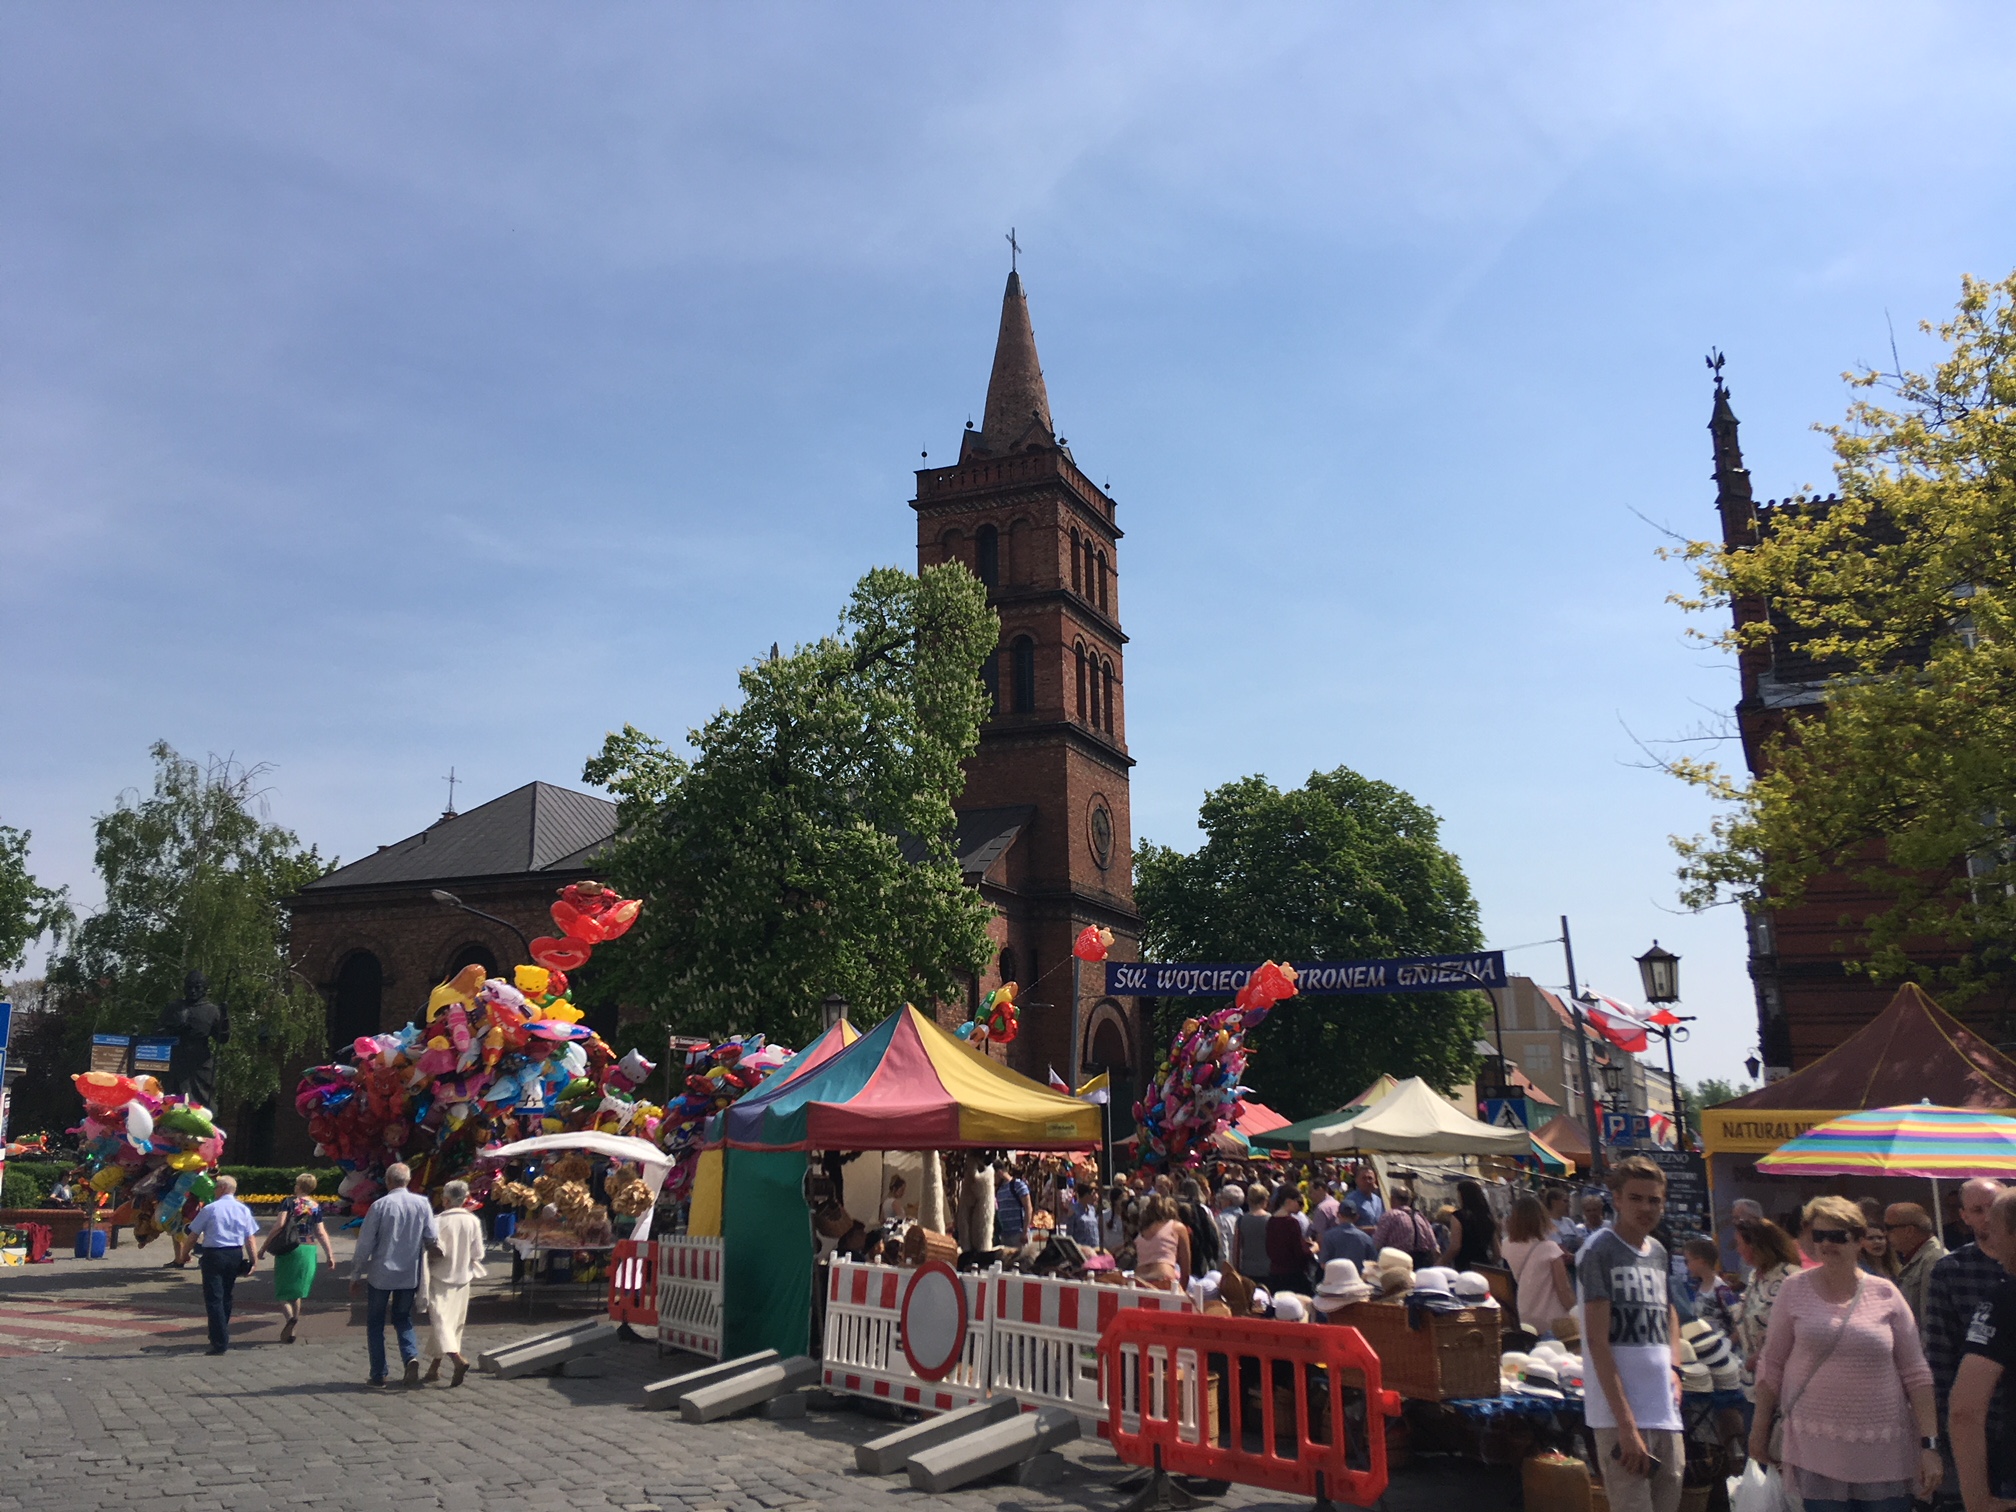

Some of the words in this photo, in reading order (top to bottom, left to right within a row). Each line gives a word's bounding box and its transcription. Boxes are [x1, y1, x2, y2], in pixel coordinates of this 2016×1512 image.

[1114, 964, 1147, 989] ŚW.
[1297, 966, 1386, 990] TRONEM
[1396, 957, 1496, 986] GNIEZNA
